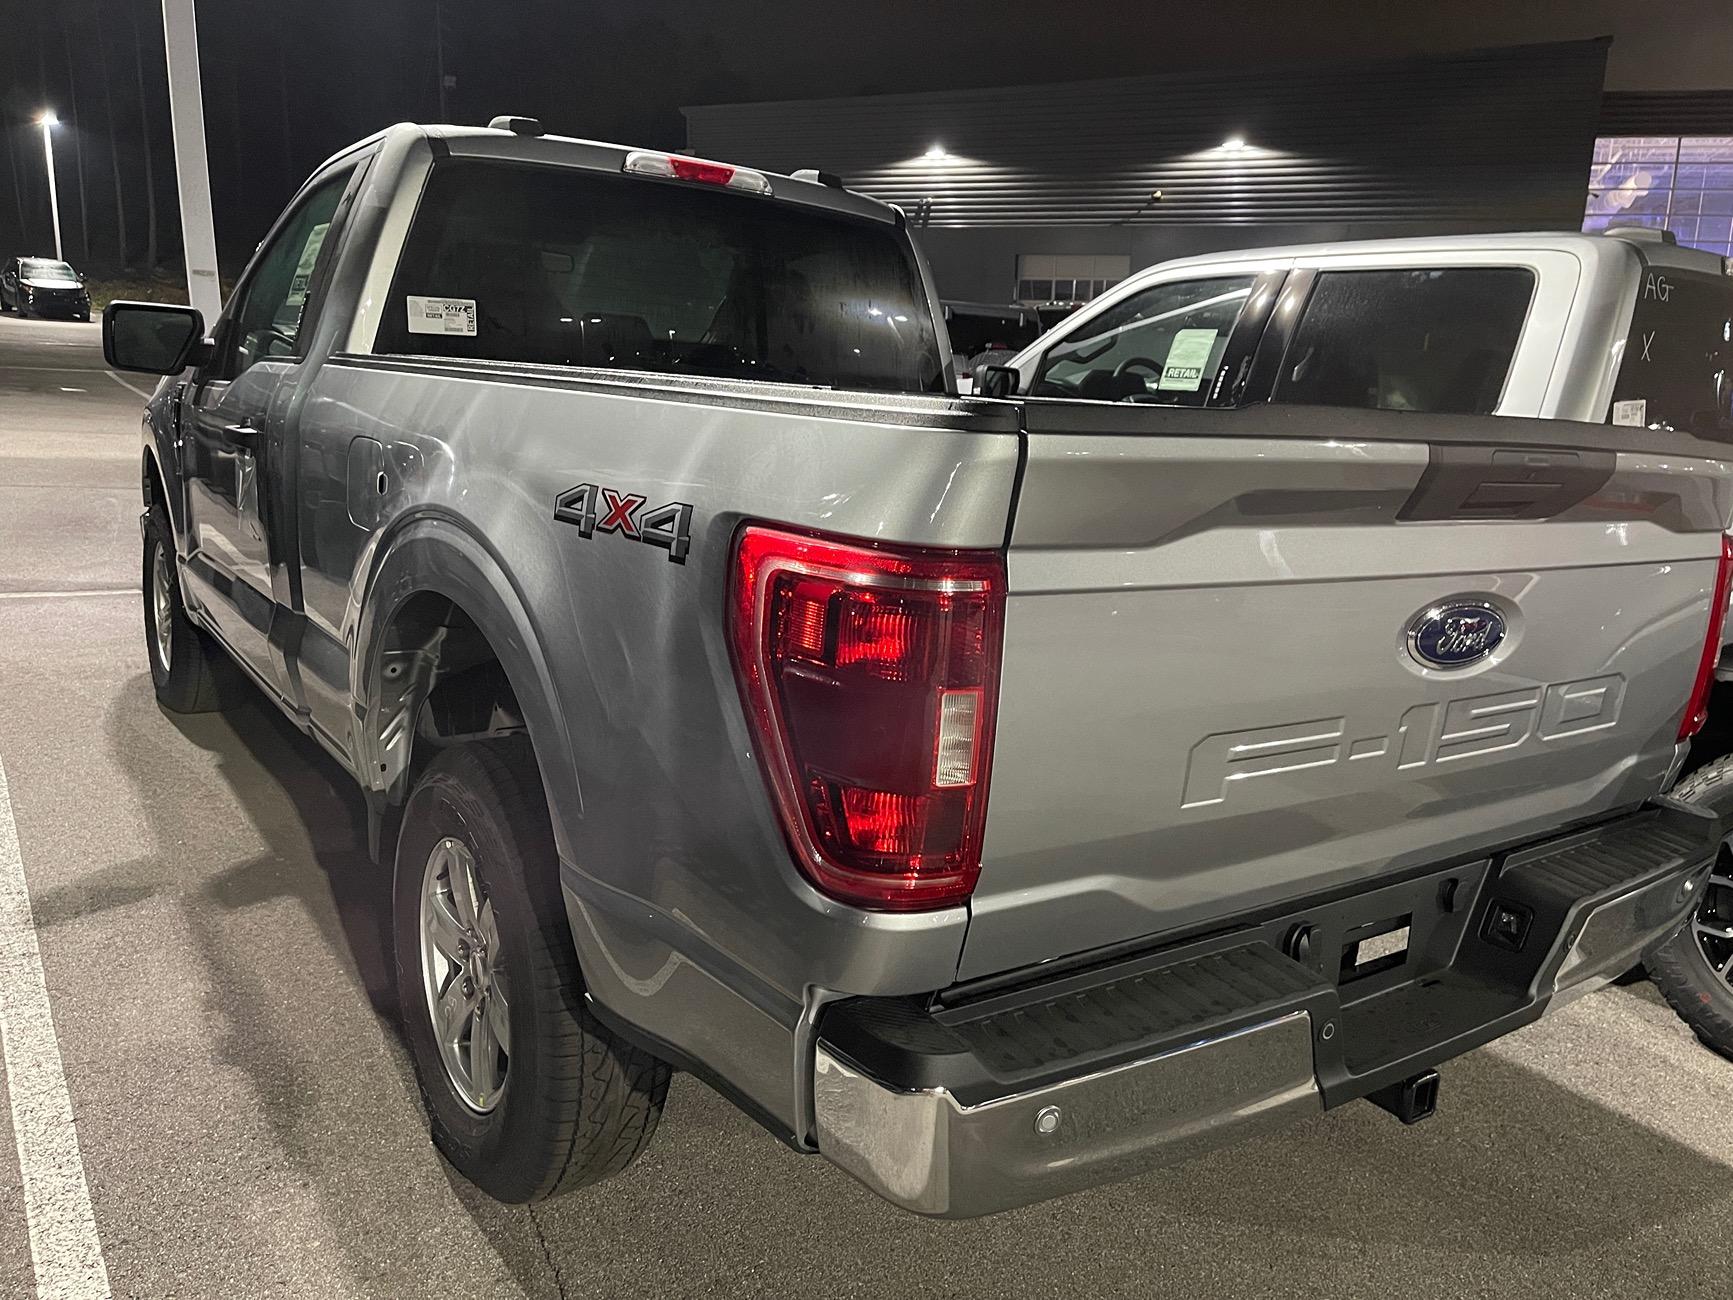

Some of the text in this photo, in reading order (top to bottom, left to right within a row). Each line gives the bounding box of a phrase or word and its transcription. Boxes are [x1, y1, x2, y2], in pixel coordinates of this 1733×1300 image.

[1644, 273, 1674, 302] AG
[1167, 368, 1199, 378] RETAIL
[1436, 616, 1493, 656] Ford
[1180, 672, 1628, 809] F-150
